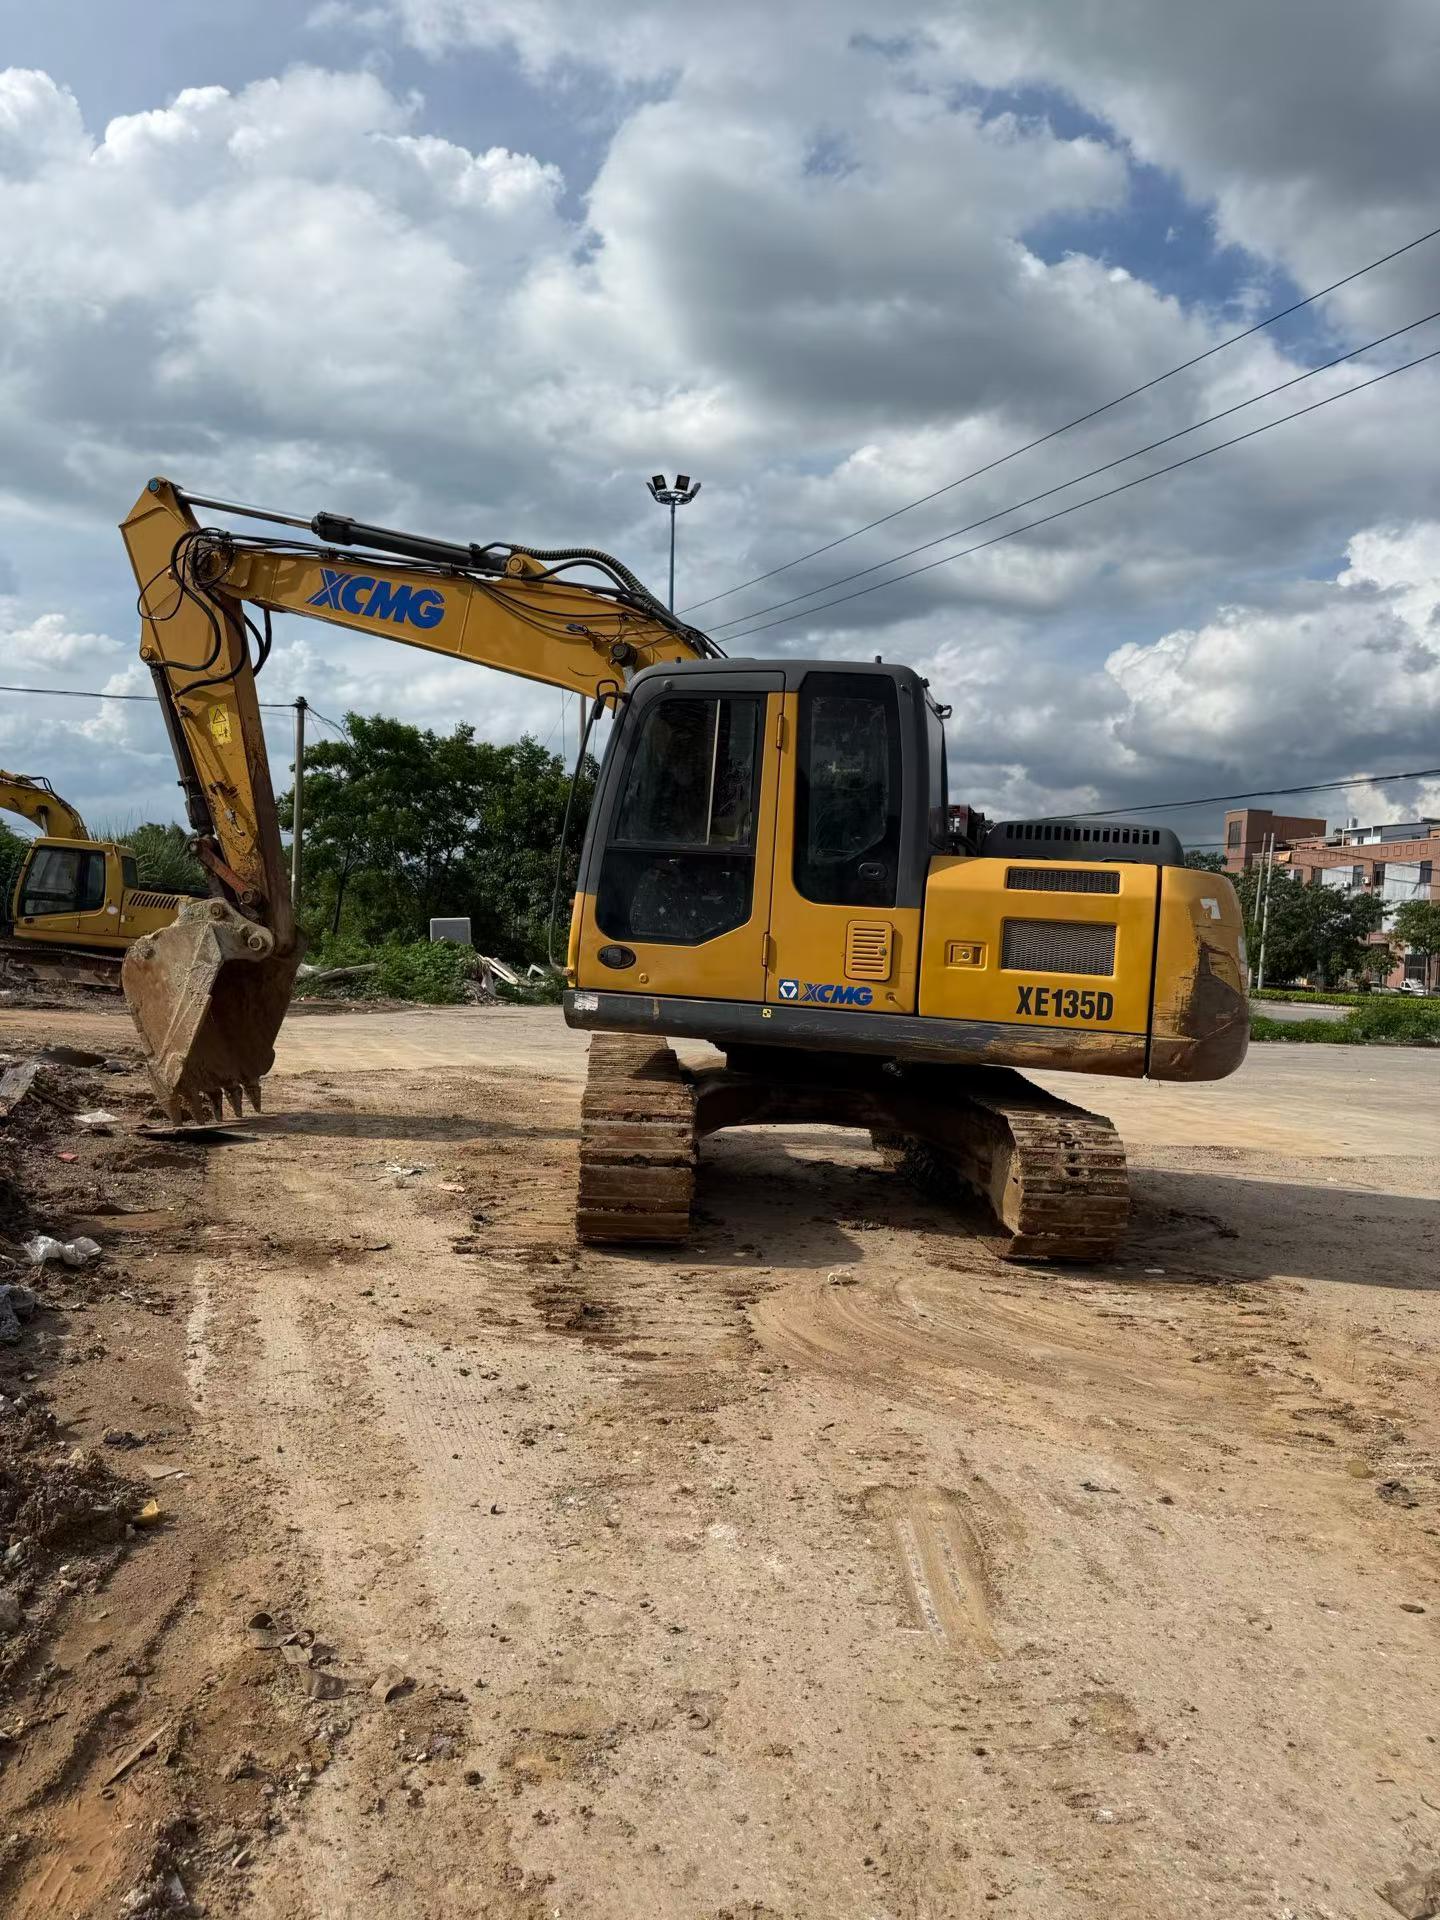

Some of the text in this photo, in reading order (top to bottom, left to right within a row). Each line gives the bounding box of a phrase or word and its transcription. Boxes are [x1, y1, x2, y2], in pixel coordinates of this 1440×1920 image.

[306, 568, 446, 629] XCMG
[801, 983, 873, 1006] XCMG
[1016, 986, 1114, 1021] XE135D
